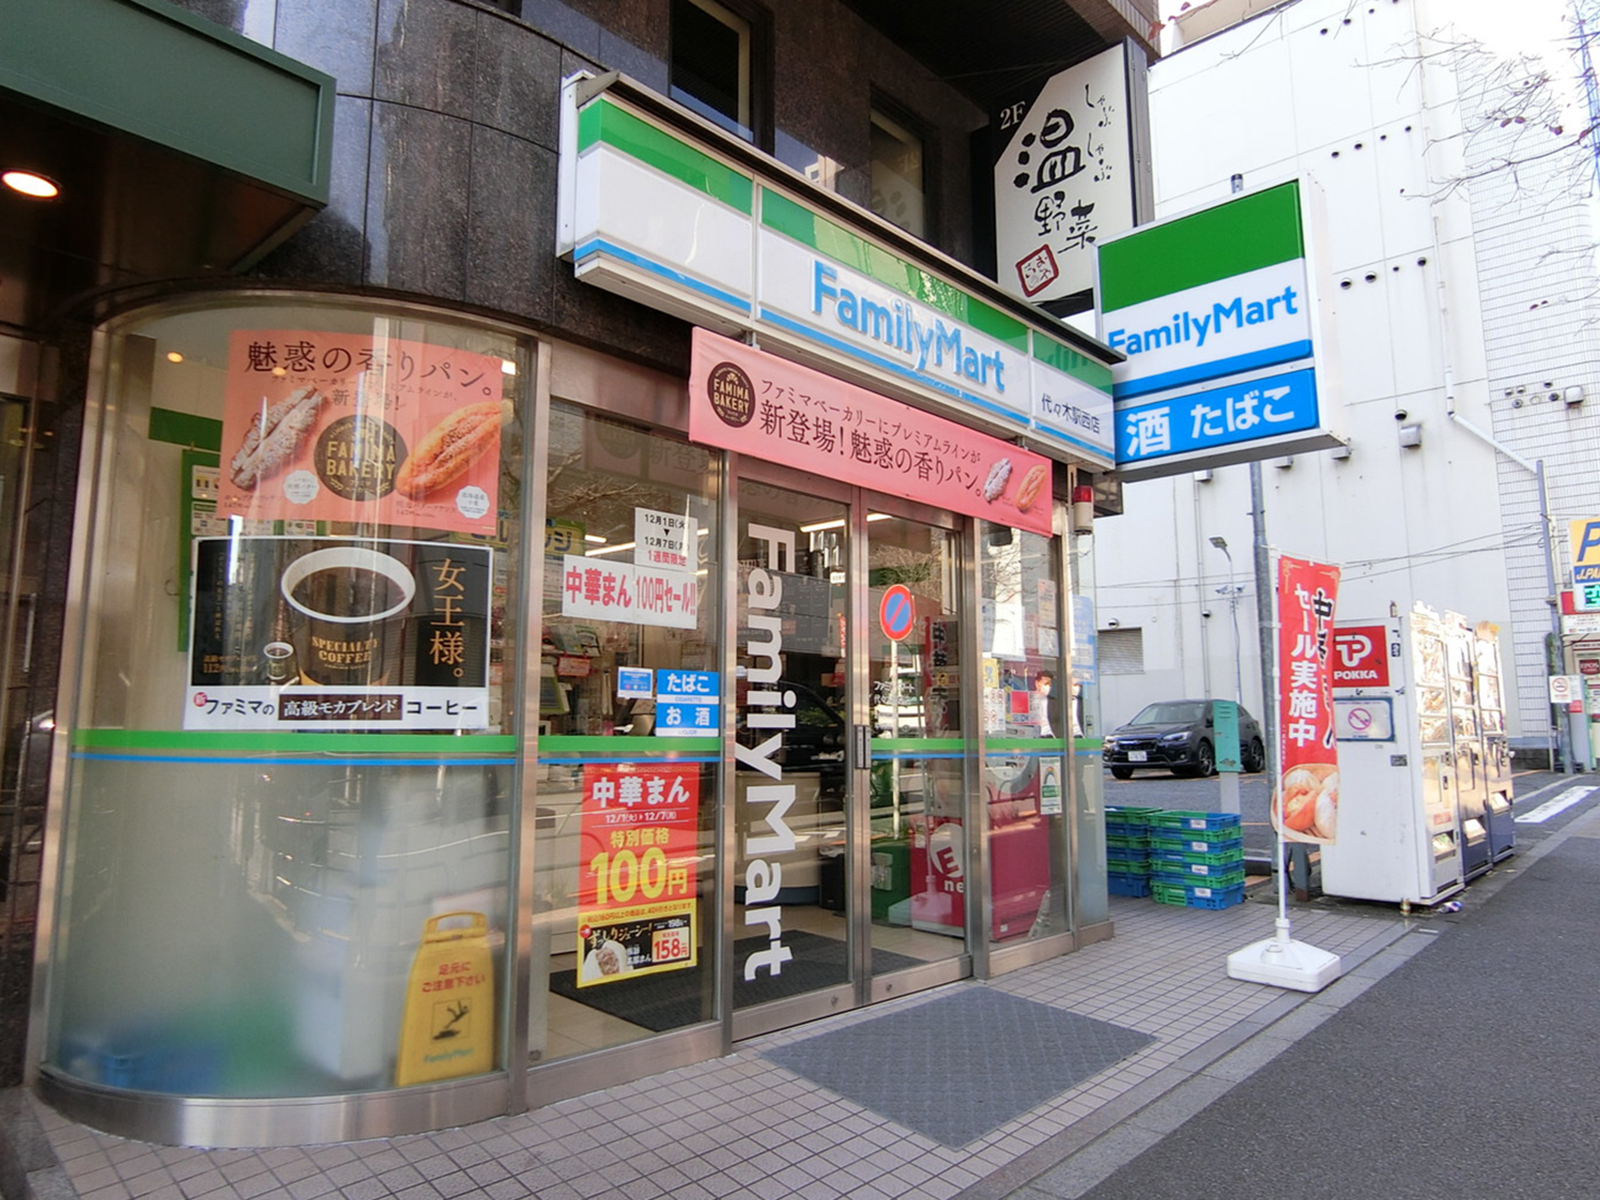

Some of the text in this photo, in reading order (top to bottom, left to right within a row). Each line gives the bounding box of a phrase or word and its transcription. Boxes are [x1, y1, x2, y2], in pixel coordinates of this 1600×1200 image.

[1000, 101, 1026, 130] 2F
[1013, 108, 1098, 254] 温野菜
[811, 258, 1006, 394] FamilyMart
[1109, 286, 1298, 356] FamilyMart
[713, 378, 750, 401] FAMIMA
[713, 392, 750, 414] BAKERY
[1041, 393, 1100, 434] 代々木駅西店
[1126, 384, 1295, 456] 酒 たばこ
[644, 514, 688, 529] 12月1日(火
[1577, 522, 1600, 562] P
[565, 565, 632, 608] 中華まん
[430, 557, 468, 678] 女王様。
[1288, 583, 1319, 748] セール実施中
[1333, 670, 1378, 680] POKKA
[666, 673, 710, 693] たばこ
[206, 698, 275, 715] ファミマの
[284, 698, 398, 717] 高級モカブレンド
[407, 699, 478, 716] コーヒー
[734, 523, 796, 982] FamilyMart
[592, 775, 690, 809] 中華まん
[610, 827, 670, 849] 特別価格
[590, 846, 688, 904] 100円
[944, 880, 964, 893] ne
[422, 974, 485, 993] ご注意下さい
[438, 961, 472, 976] 足元に
